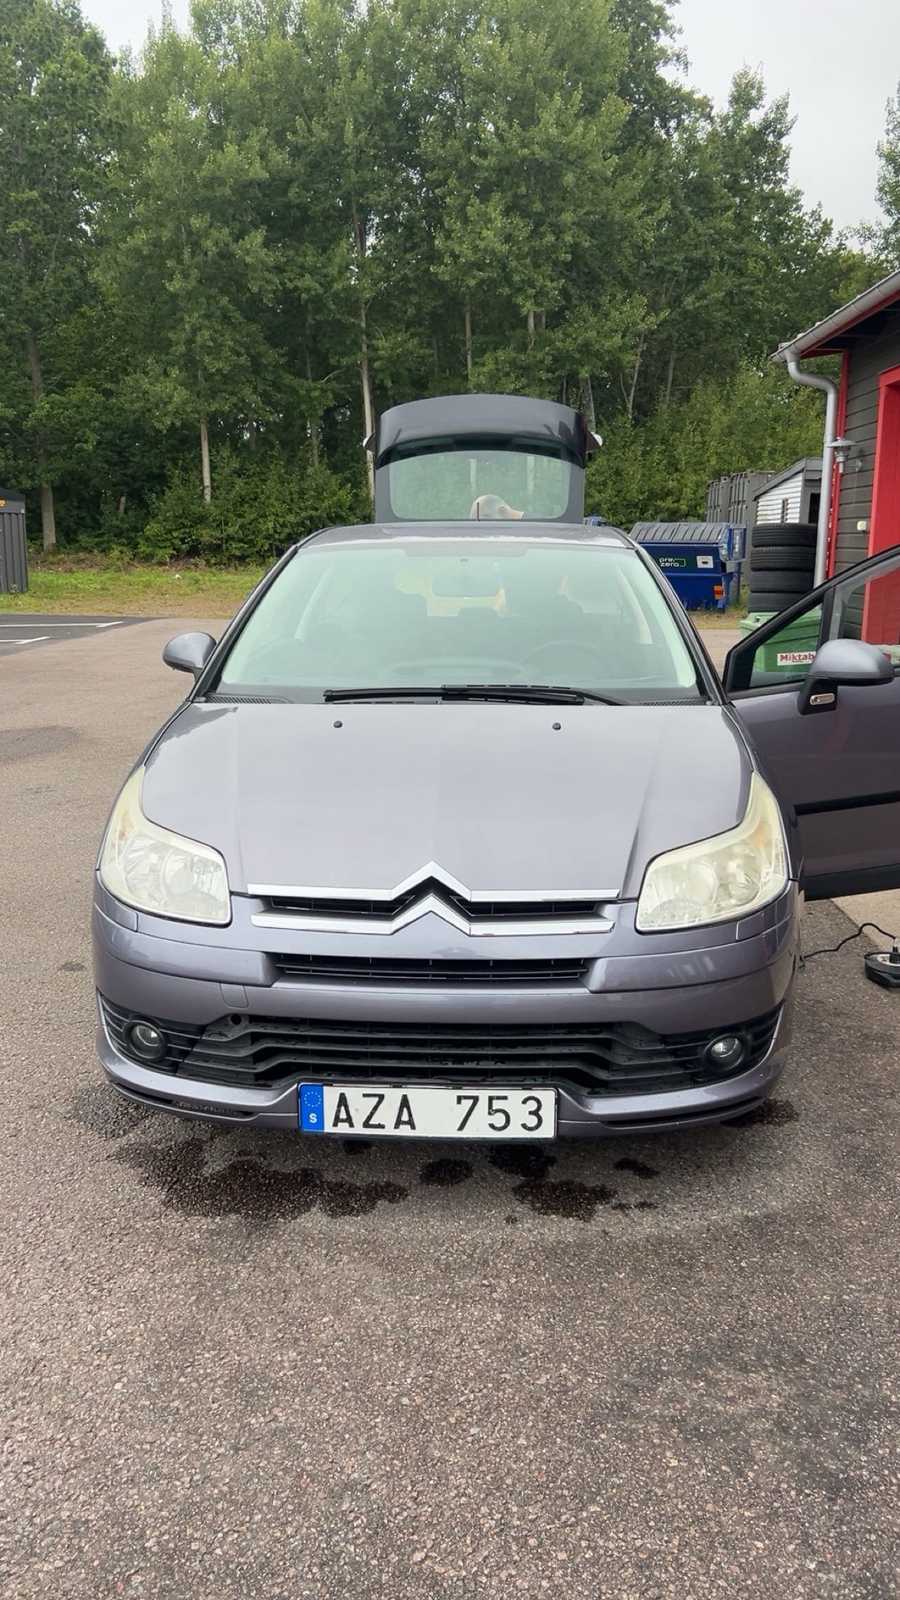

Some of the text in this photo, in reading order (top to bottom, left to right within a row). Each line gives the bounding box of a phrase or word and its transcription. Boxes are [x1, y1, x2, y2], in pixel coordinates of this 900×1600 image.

[309, 1113, 317, 1124] S
[332, 1092, 543, 1132] AZA 753
